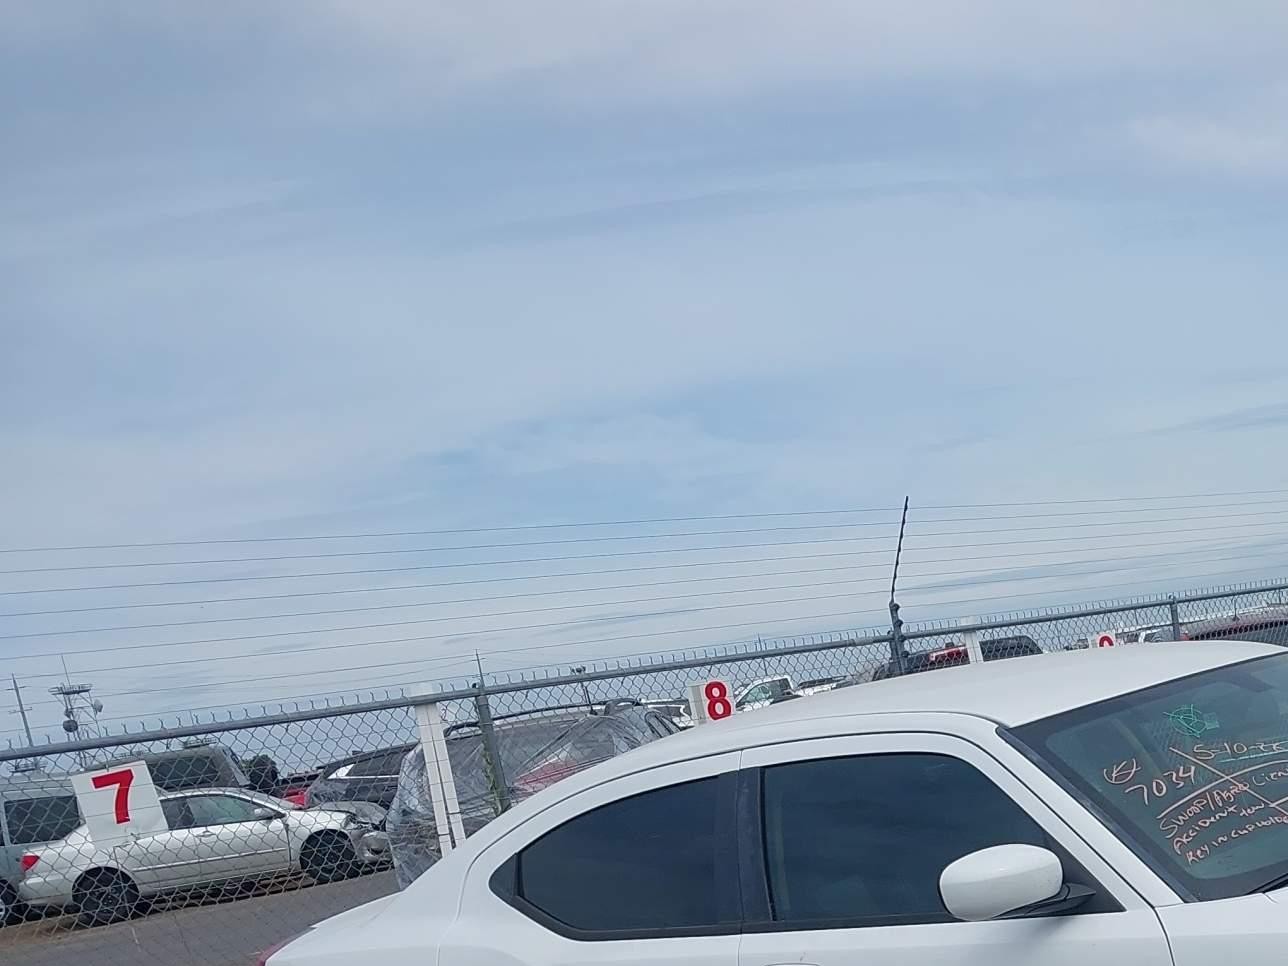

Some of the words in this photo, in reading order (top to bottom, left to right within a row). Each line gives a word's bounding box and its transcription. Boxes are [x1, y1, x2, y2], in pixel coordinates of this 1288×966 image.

[704, 681, 732, 721] 8
[91, 768, 134, 825] 7
[1124, 765, 1197, 807] 7034
